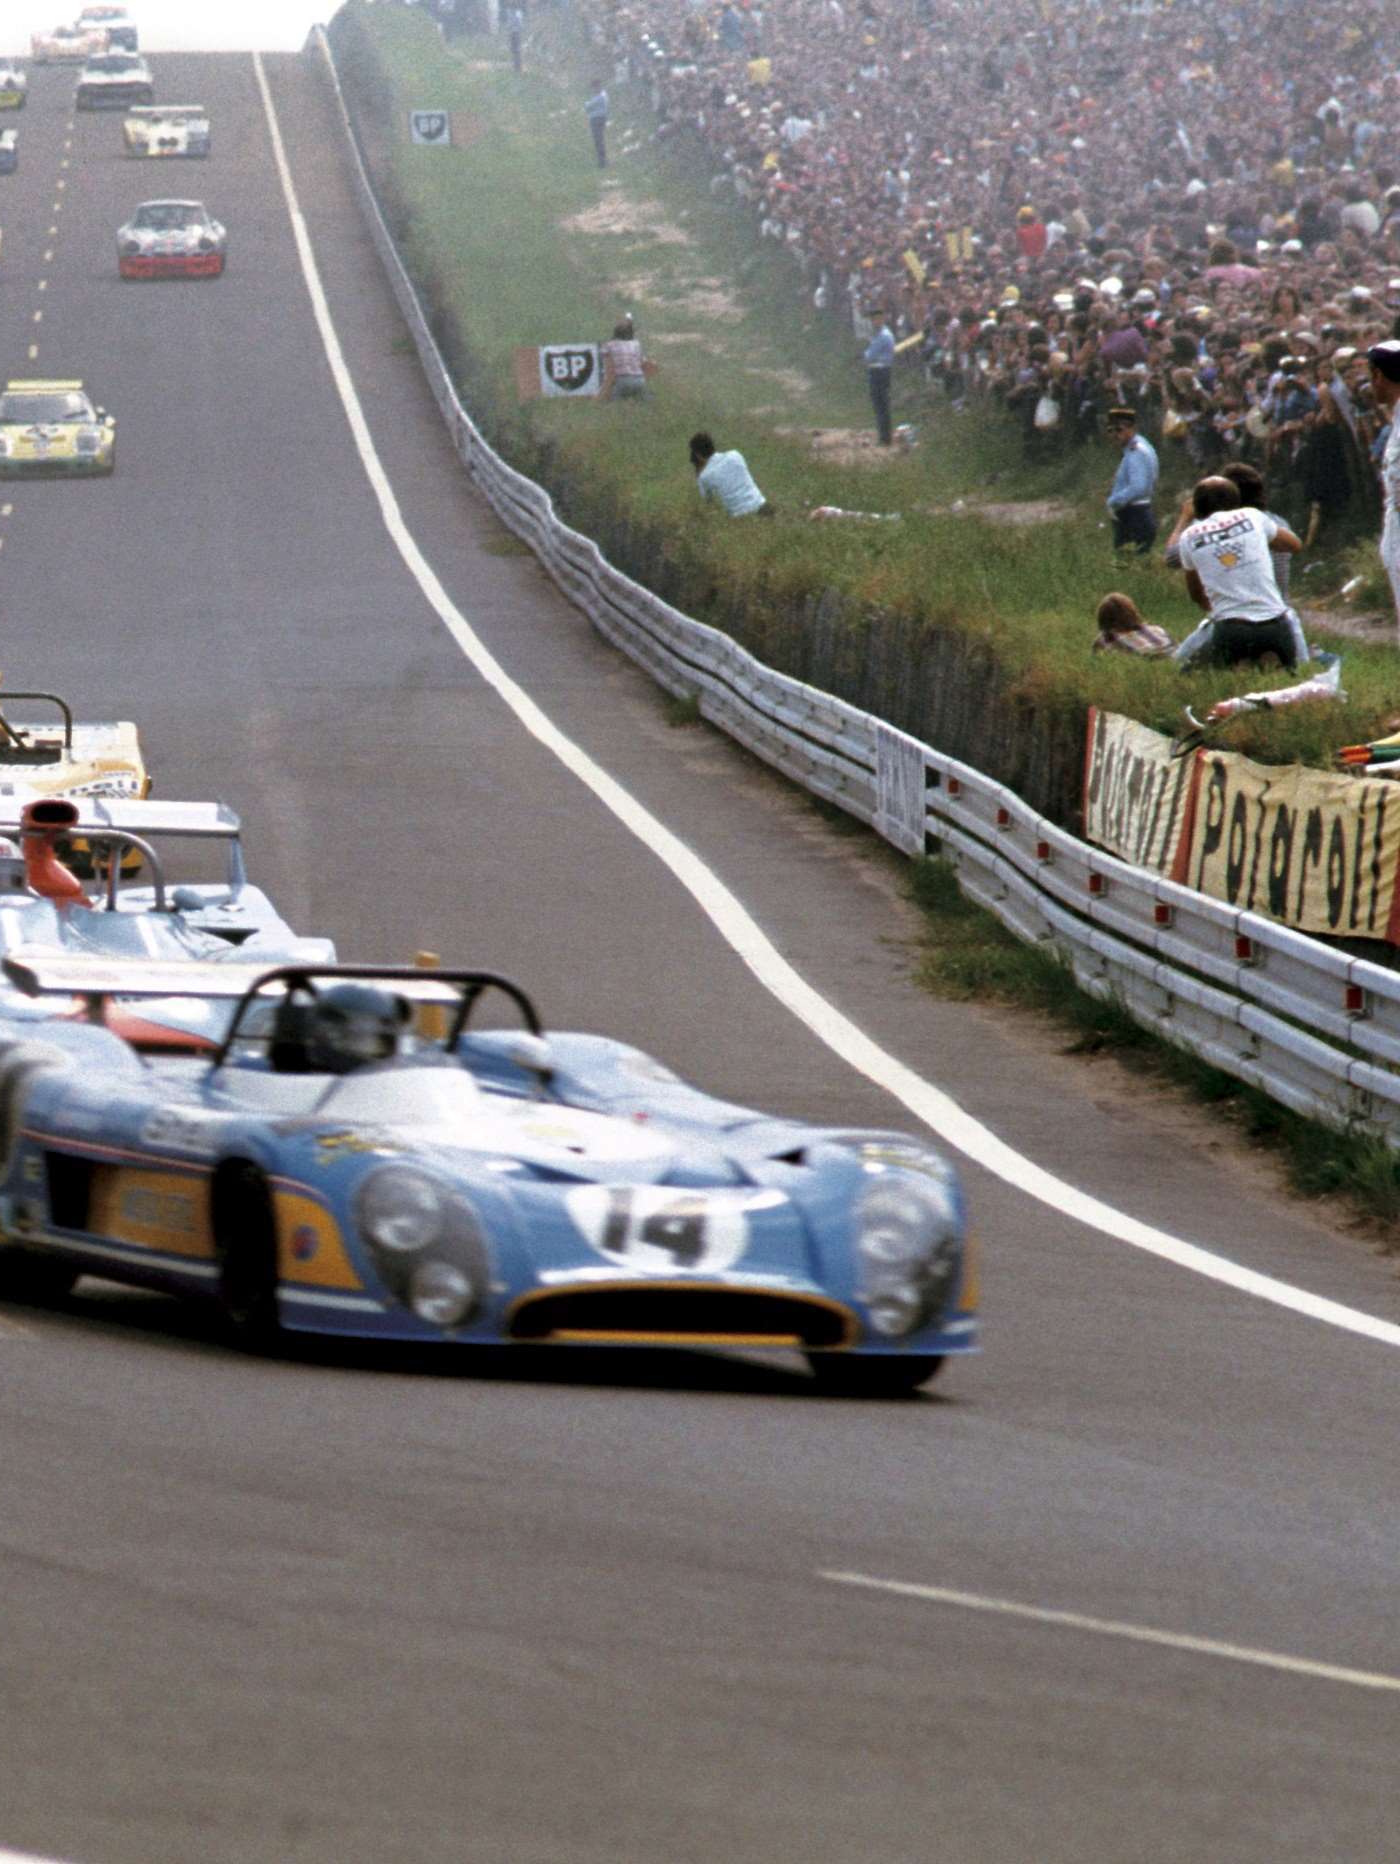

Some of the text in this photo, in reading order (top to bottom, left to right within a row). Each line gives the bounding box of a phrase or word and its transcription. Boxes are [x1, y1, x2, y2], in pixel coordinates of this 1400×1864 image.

[420, 118, 440, 132] BP
[552, 355, 586, 378] BP
[602, 1187, 710, 1268] 14
